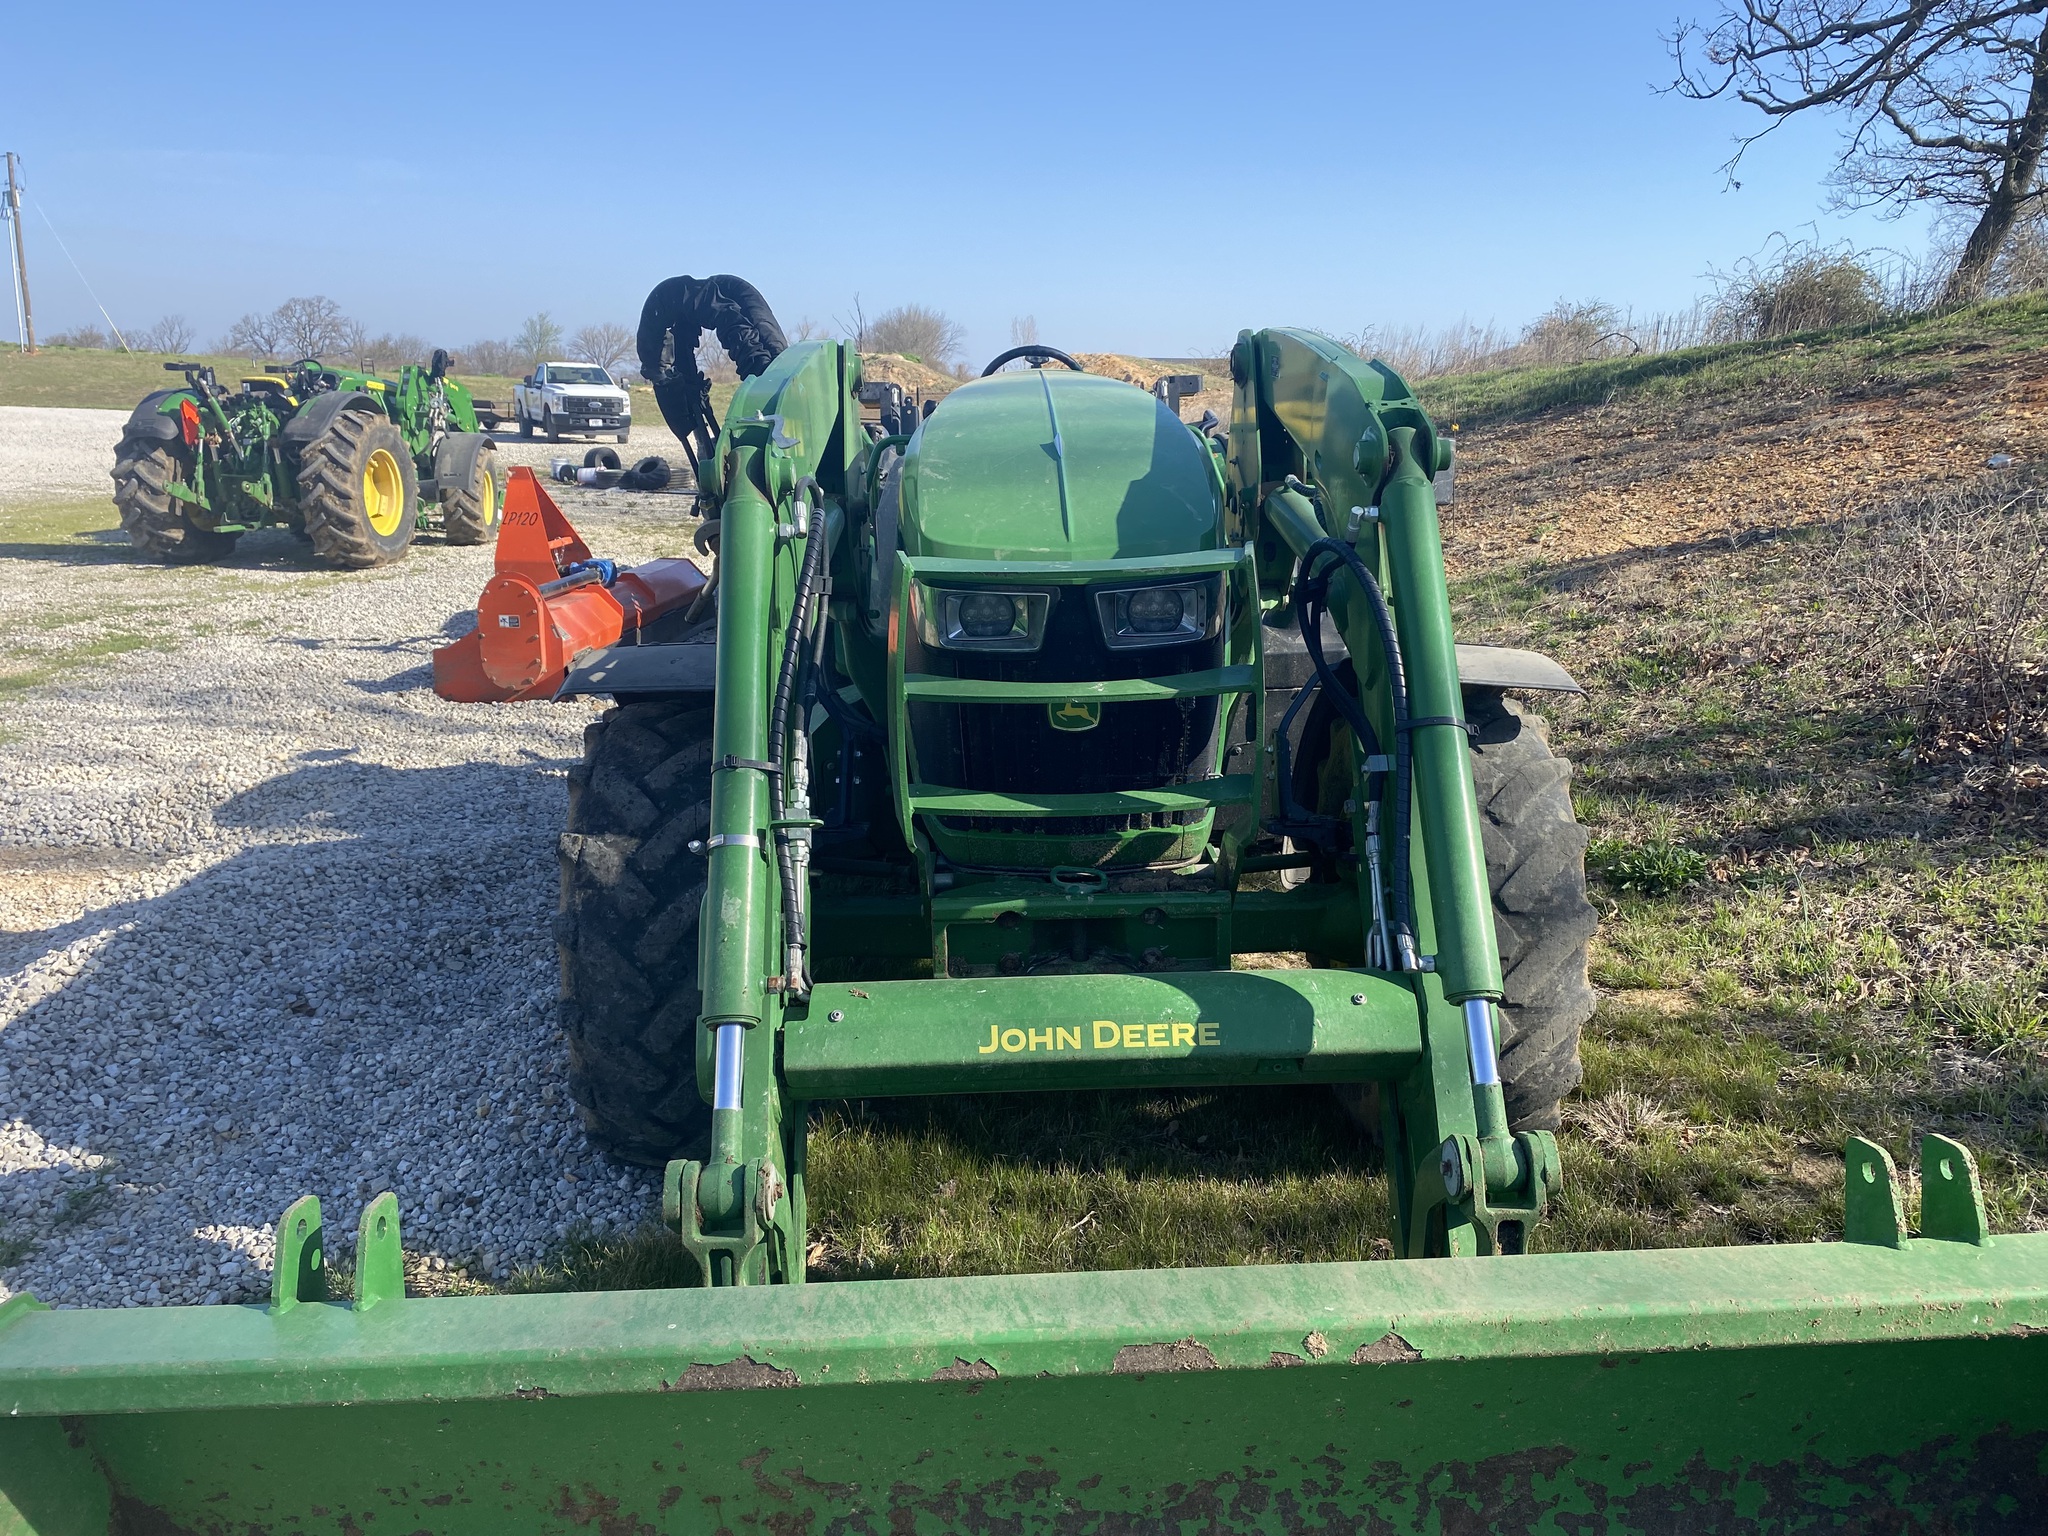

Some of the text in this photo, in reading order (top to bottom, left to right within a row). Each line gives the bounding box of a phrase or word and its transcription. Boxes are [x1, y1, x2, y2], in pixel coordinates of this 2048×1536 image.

[502, 511, 539, 526] LP120
[979, 1020, 1221, 1054] JOHN DEERE
